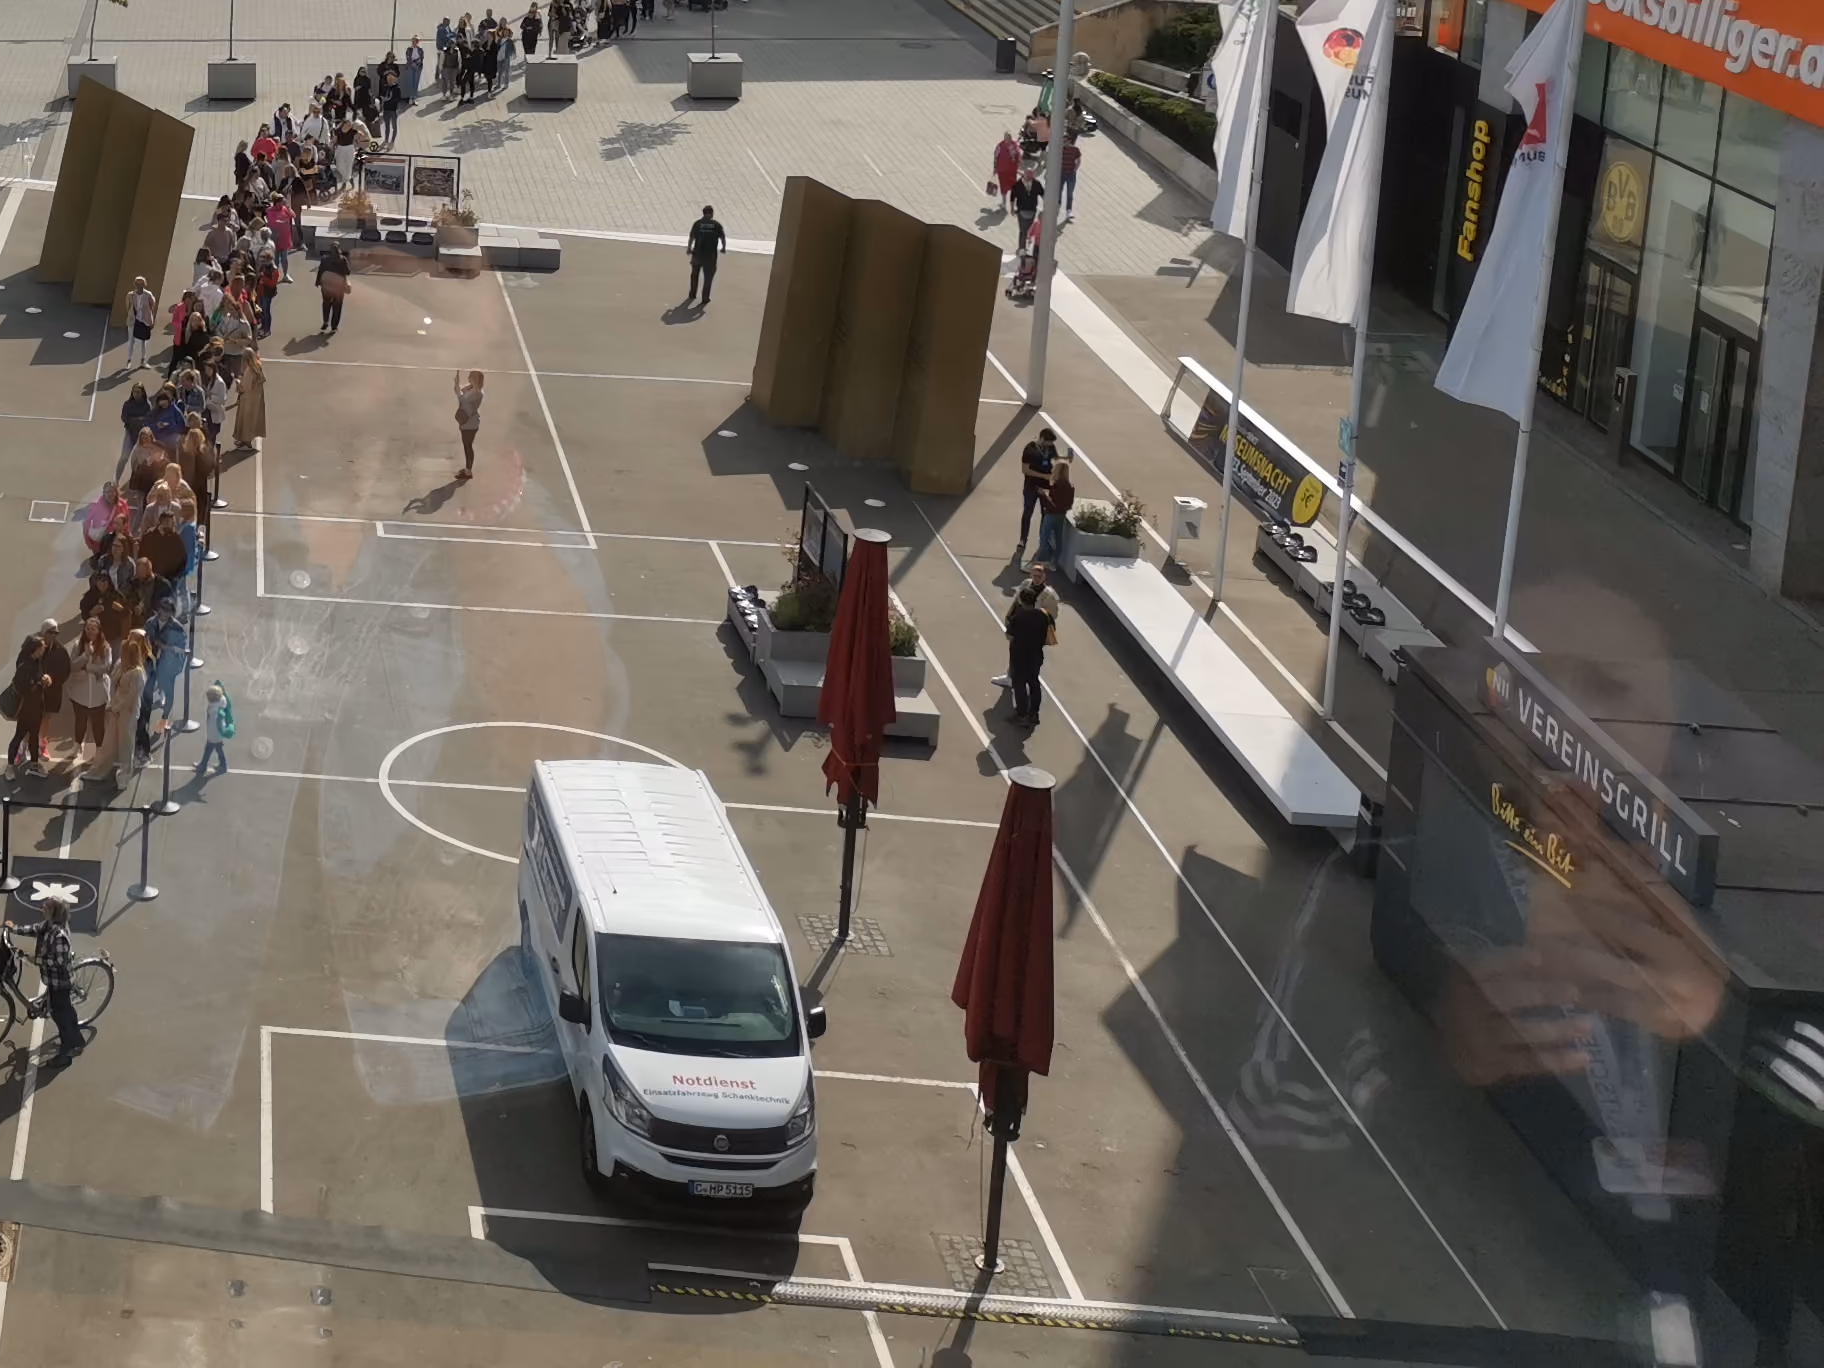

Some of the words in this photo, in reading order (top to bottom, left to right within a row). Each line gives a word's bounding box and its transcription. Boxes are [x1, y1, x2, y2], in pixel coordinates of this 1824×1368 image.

[1457, 119, 1491, 262] Fanshop
[1606, 168, 1637, 221] BVB
[1219, 424, 1292, 495] MSEUMSNACHT
[1238, 464, 1267, 497] September
[1265, 487, 1282, 509] 2023
[1518, 687, 1687, 876] VEREINSGRILL
[1491, 782, 1521, 832] Bitte
[1523, 825, 1544, 855] ein
[1547, 833, 1574, 874] Bit
[643, 1088, 719, 1099] Einsatzfahrzeug
[721, 1091, 790, 1105] Schanktechnik
[672, 1075, 757, 1090] Notdienst
